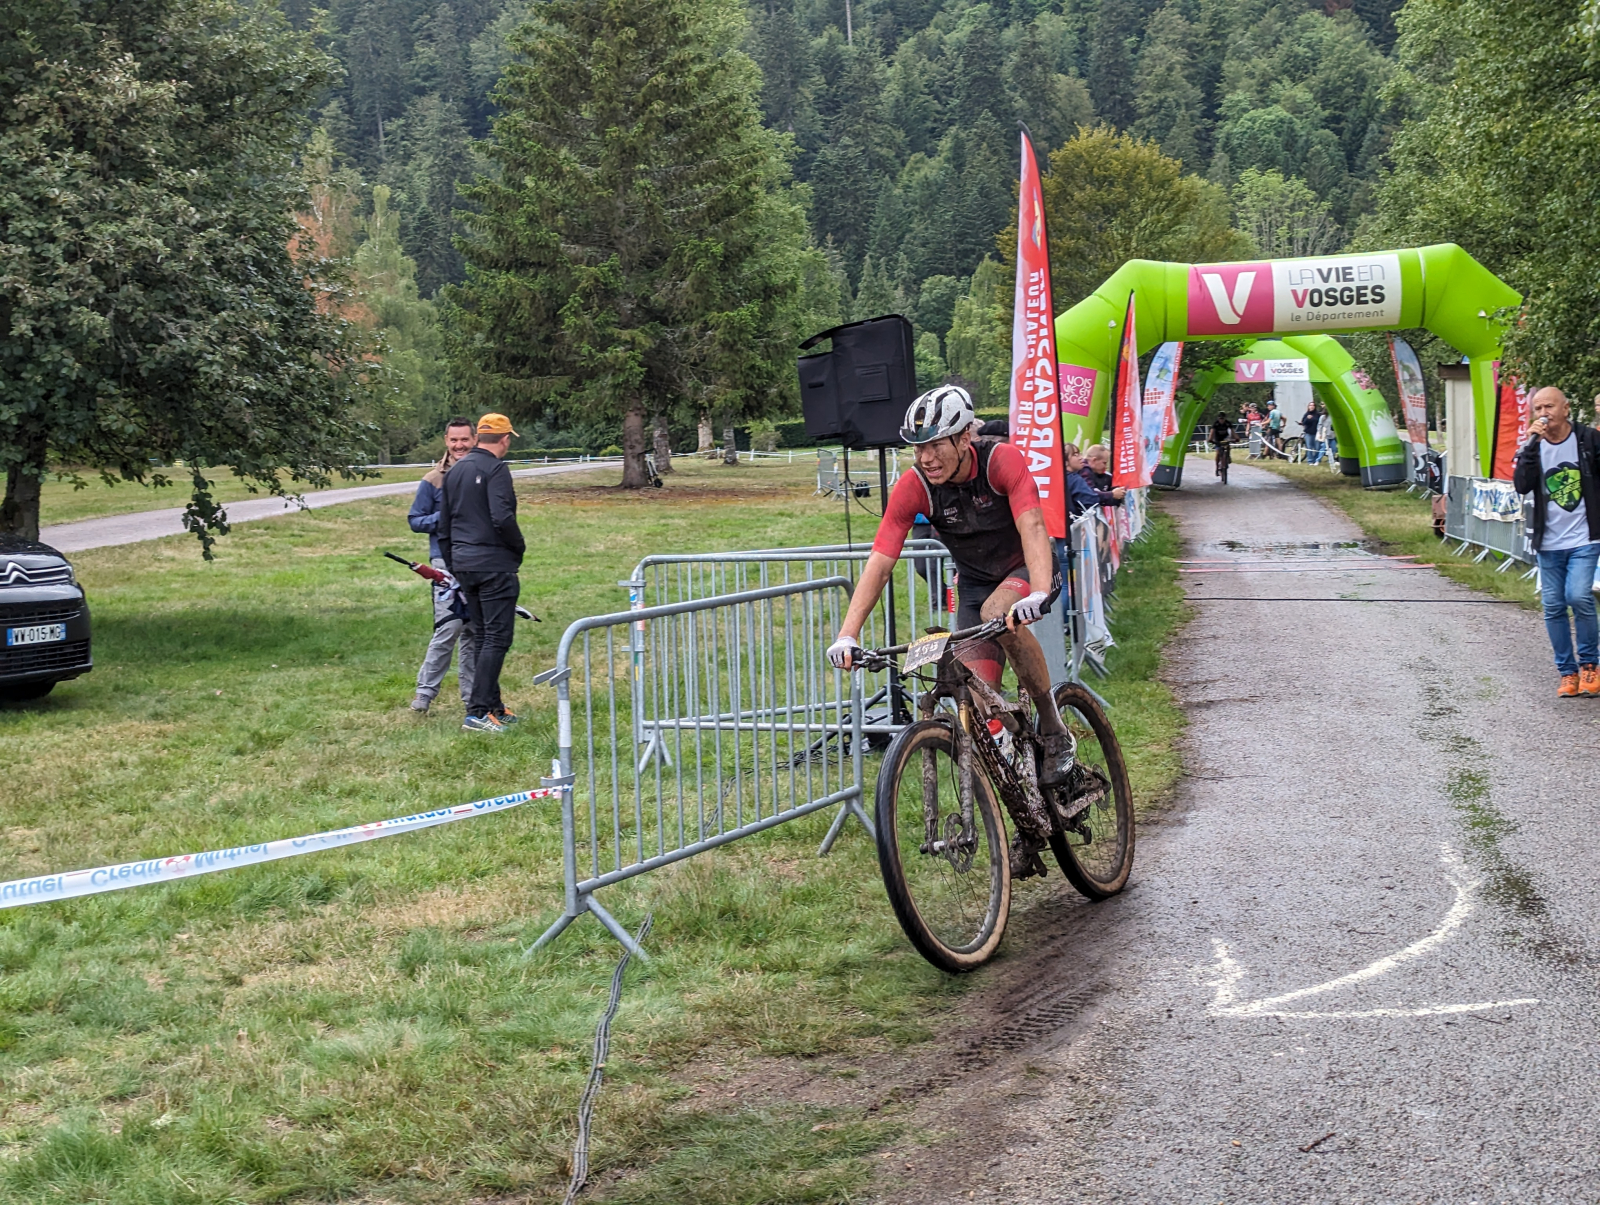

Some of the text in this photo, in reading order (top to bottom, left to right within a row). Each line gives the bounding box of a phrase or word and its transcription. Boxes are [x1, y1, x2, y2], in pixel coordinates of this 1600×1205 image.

[1288, 264, 1386, 286] LA VIE EN
[1290, 285, 1386, 309] VOSGES
[1290, 309, 1385, 324] le Département
[1060, 392, 1089, 407] OSGES
